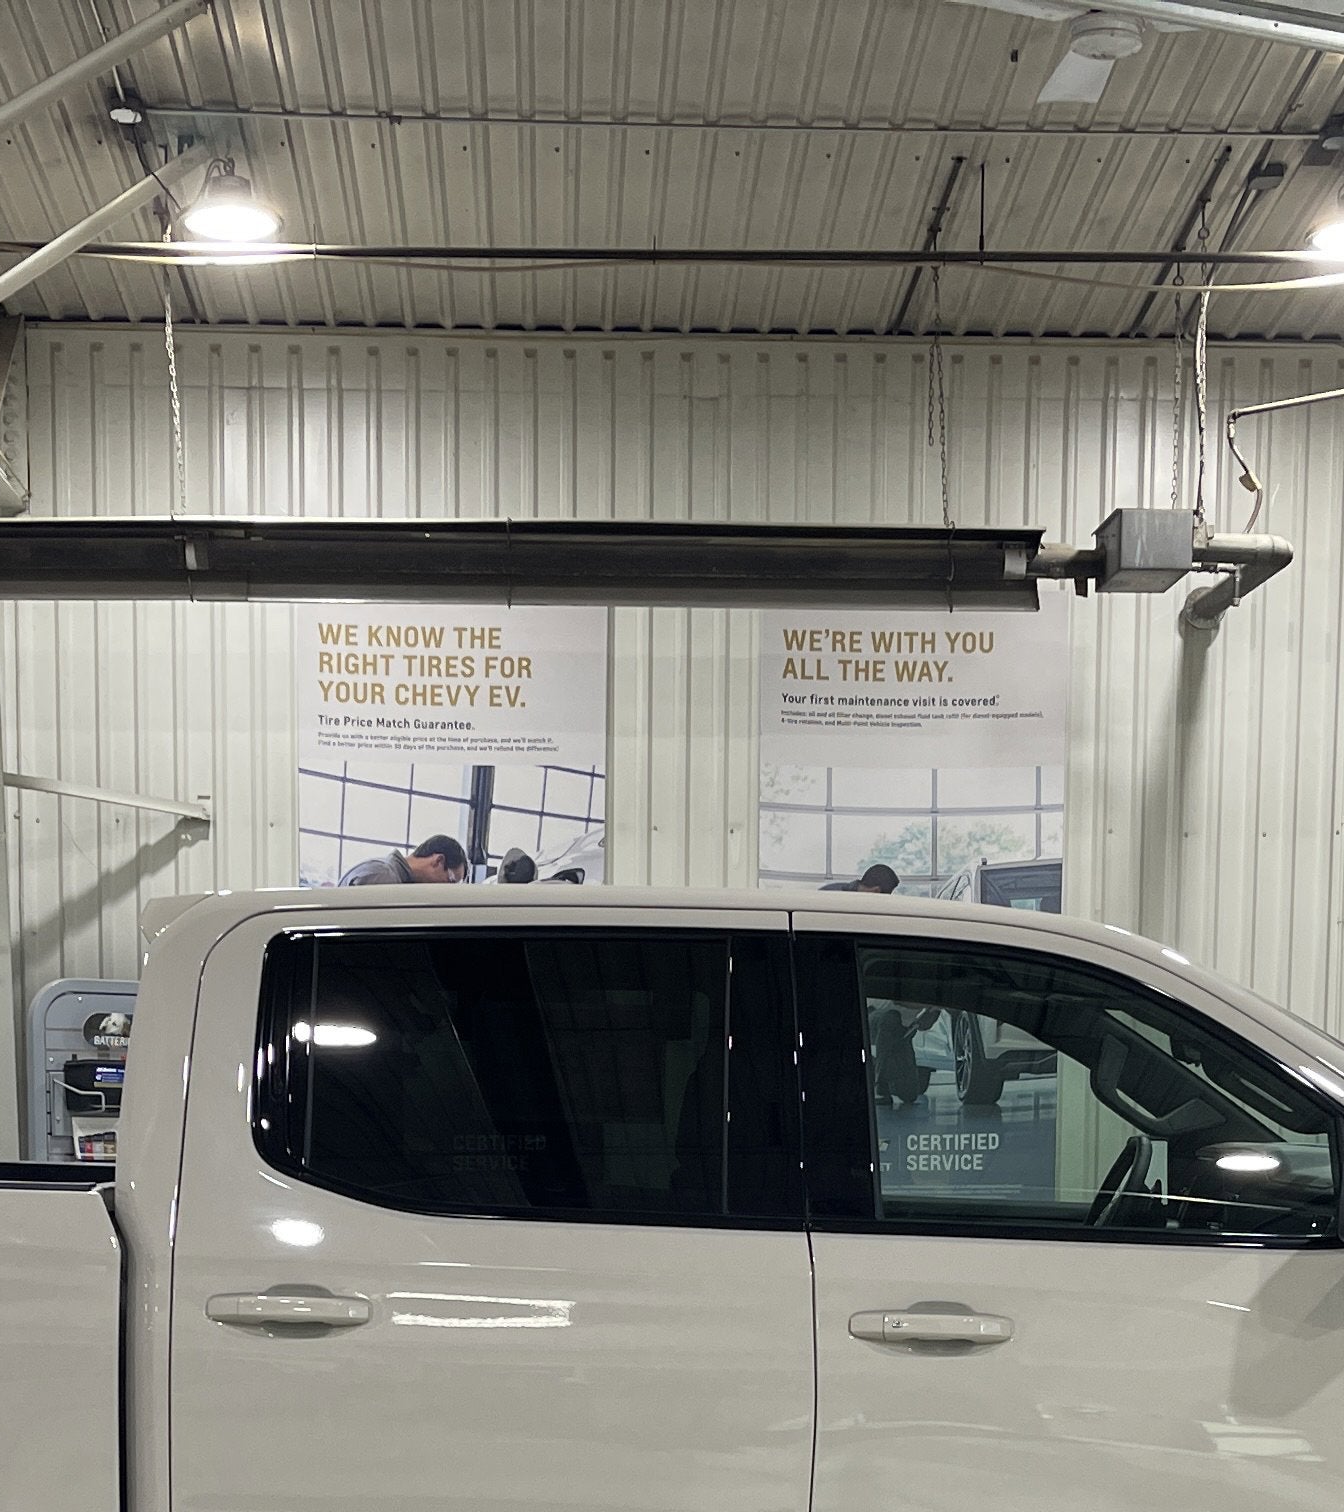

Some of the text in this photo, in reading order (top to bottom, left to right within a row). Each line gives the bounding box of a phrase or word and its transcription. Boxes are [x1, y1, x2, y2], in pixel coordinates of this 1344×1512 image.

[318, 623, 502, 650] WE KNOW THE
[783, 629, 995, 654] WE’RE WITH YOU
[318, 652, 533, 679] RIGHT TIRES FOR
[782, 657, 954, 683] ALL THE WAY.
[318, 680, 527, 708] YOUR CHEVY EV.
[781, 693, 806, 705] Your
[809, 693, 834, 706] first
[838, 694, 910, 707] maintenance
[912, 694, 936, 707] visit
[939, 695, 949, 707] is
[318, 714, 476, 731] Tire Price Match Guarantee.
[906, 1133, 1000, 1151] CERTIFIED
[906, 1154, 983, 1171] SERVICE
